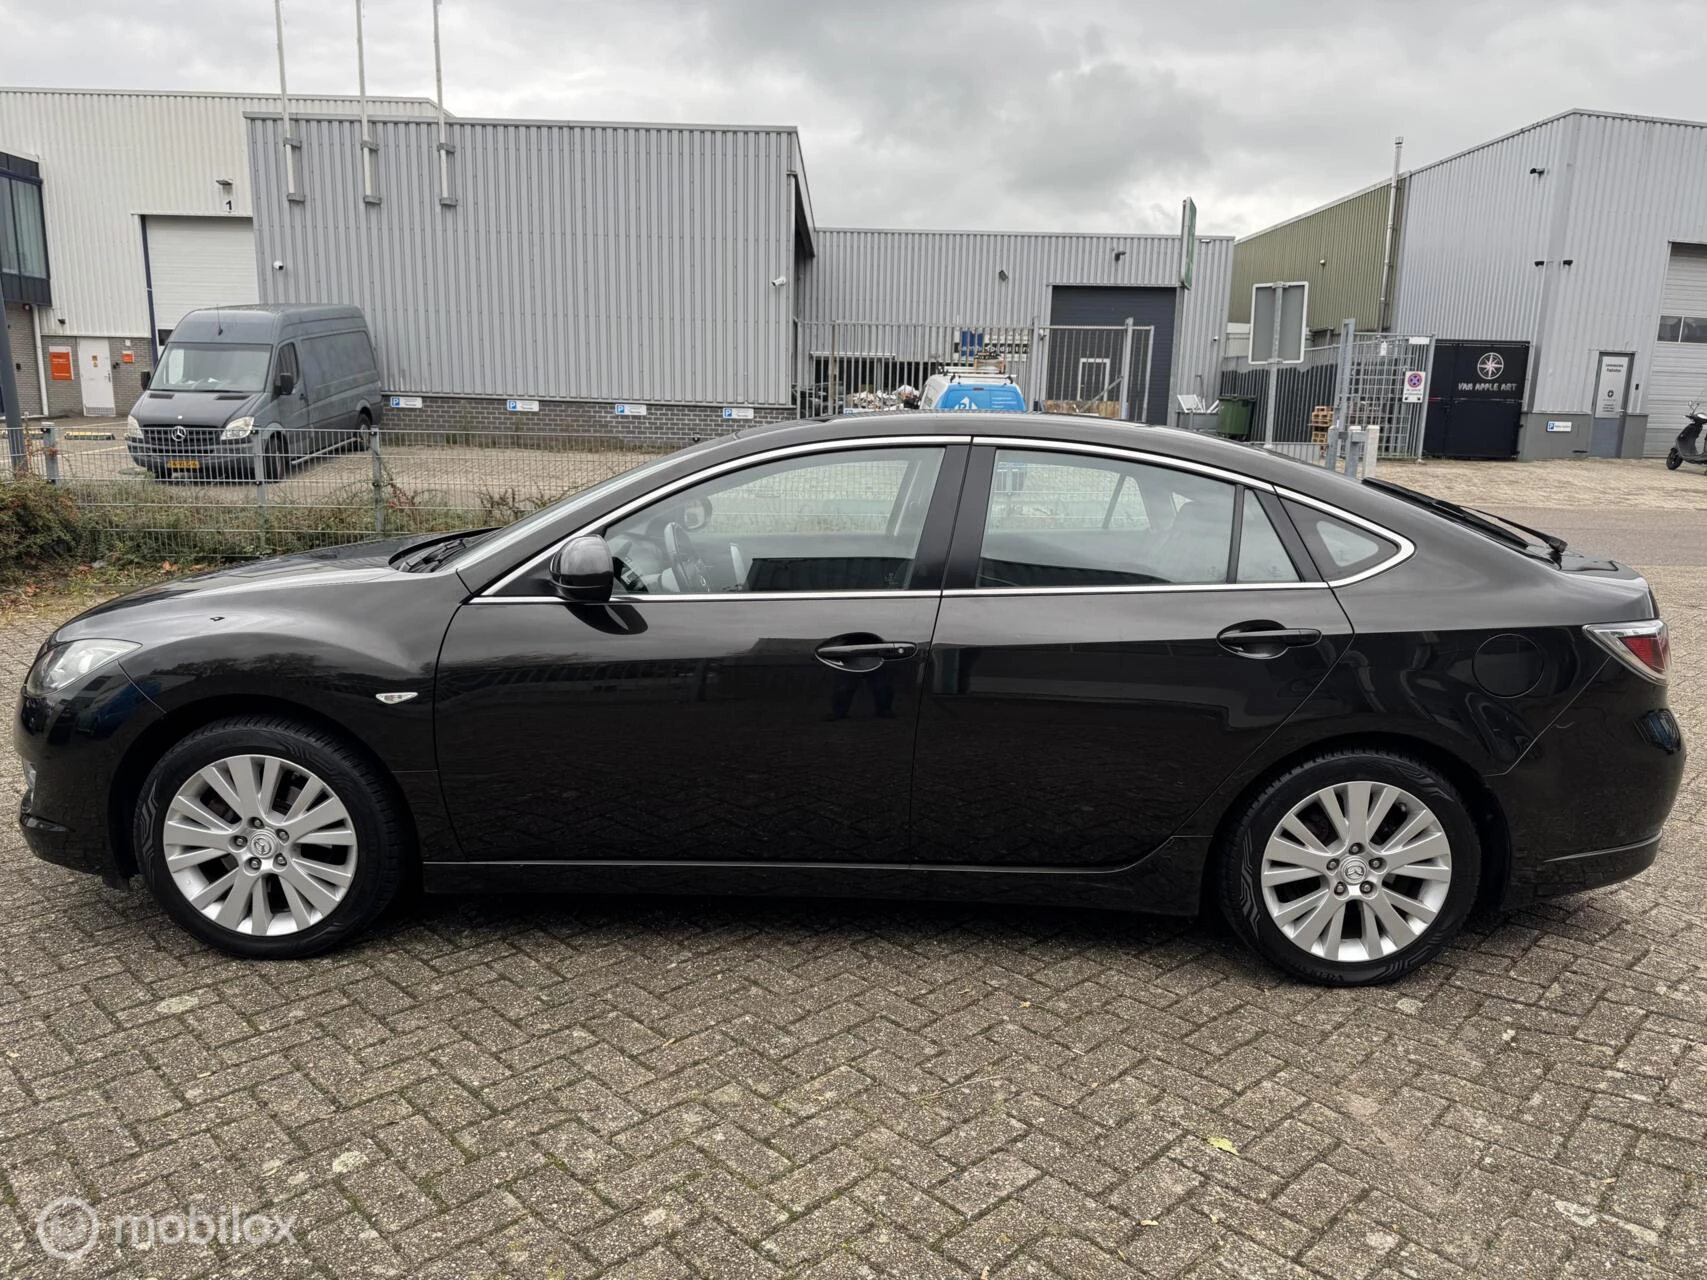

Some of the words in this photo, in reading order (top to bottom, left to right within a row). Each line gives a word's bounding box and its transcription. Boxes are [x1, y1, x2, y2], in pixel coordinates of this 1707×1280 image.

[225, 200, 232, 210] 1
[1458, 382, 1473, 391] VAN
[1475, 383, 1499, 391] APPLE
[1500, 383, 1517, 391] ART
